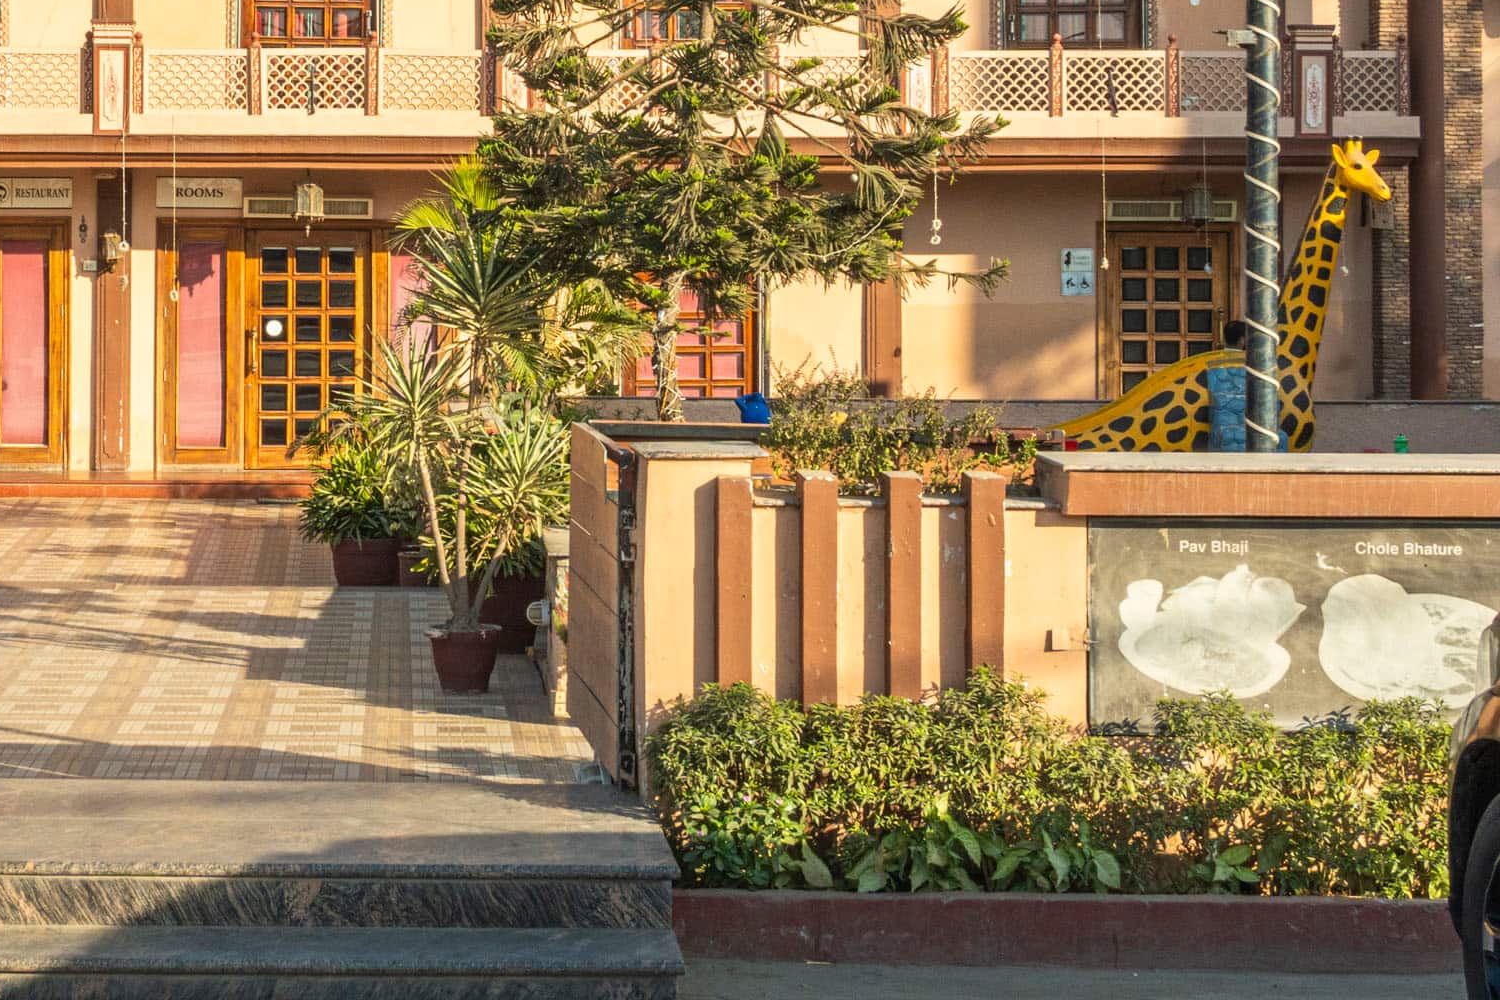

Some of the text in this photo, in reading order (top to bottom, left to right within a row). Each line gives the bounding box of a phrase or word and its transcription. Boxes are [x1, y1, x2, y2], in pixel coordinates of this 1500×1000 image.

[15, 187, 69, 198] RESTAURANT
[175, 187, 224, 198] ROOMS
[1179, 540, 1249, 556] Pav Bhaji
[1355, 542, 1463, 556] Chole Bhature
